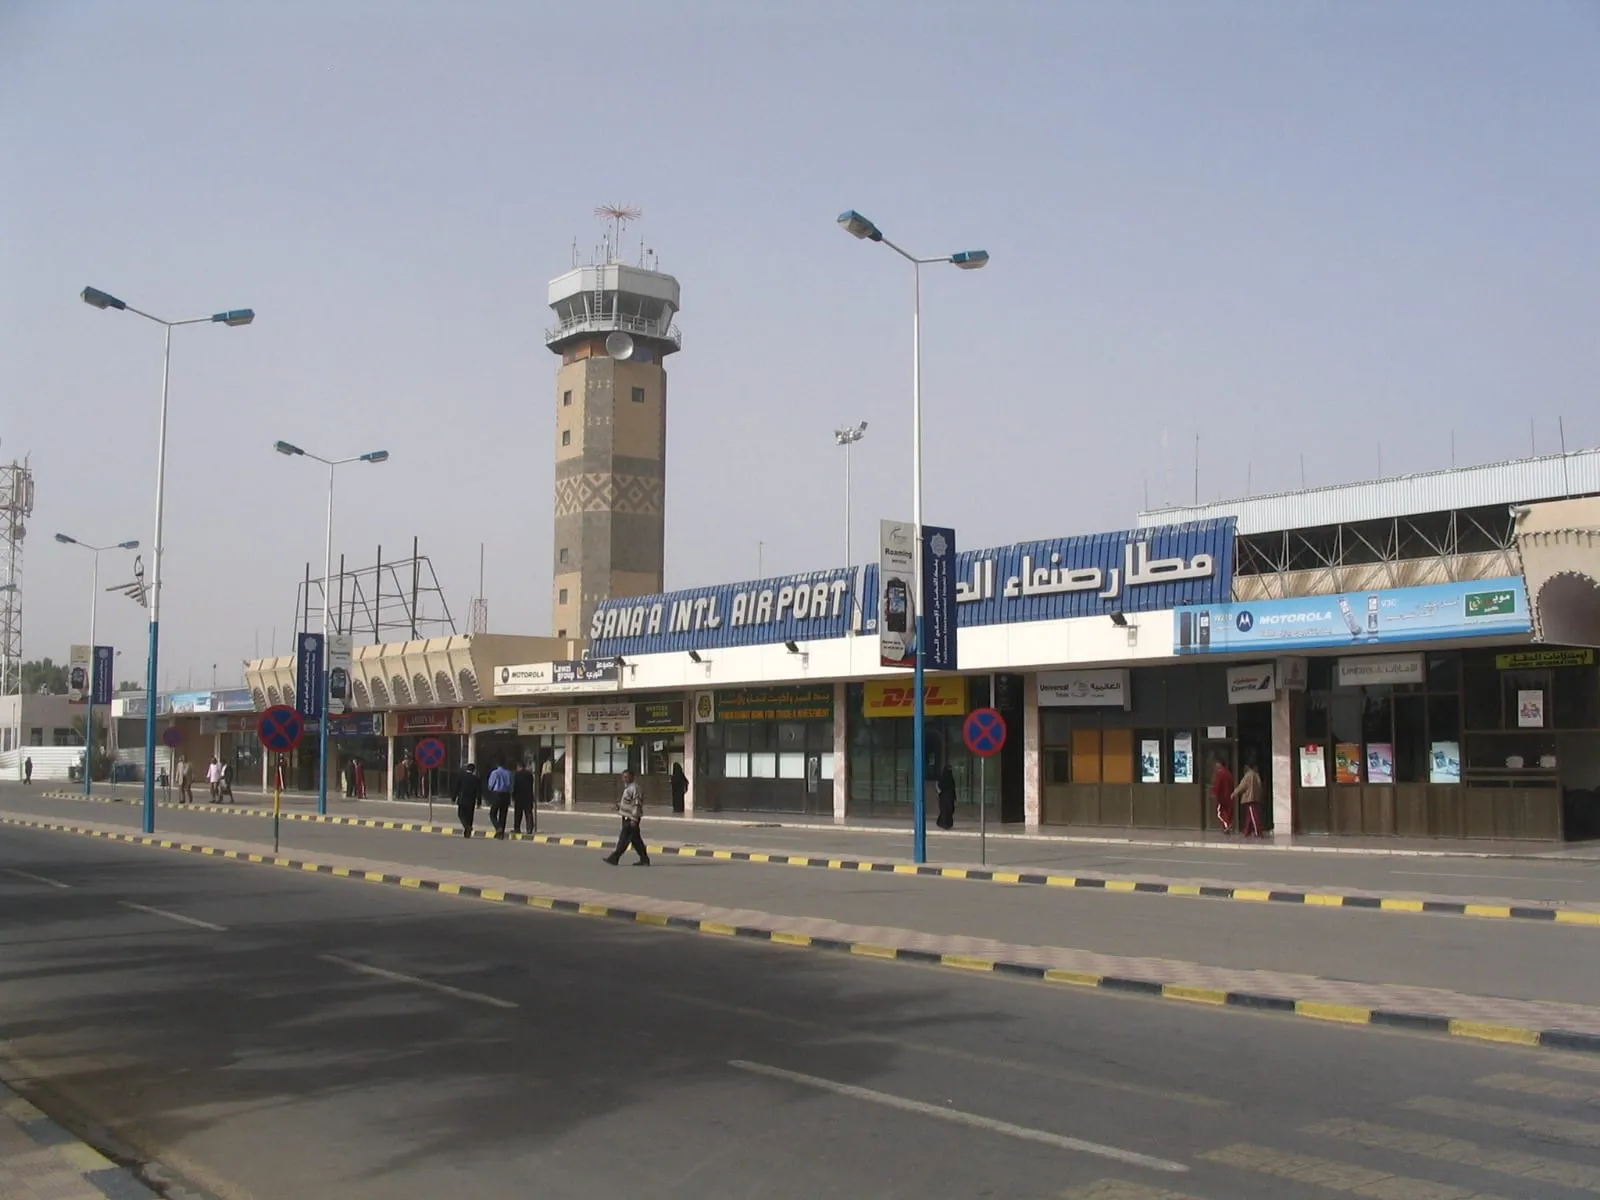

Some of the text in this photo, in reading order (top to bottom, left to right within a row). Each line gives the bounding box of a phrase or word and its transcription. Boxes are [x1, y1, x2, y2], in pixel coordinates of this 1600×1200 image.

[885, 548, 912, 559] Roaming
[1003, 553, 1102, 597] صنعاء
[1100, 541, 1213, 598] مطار
[590, 602, 662, 640] SANA'A
[730, 580, 846, 627] AIRPORT
[1259, 611, 1332, 625] MOTOROLA
[511, 671, 544, 679] MOTOROLA
[882, 687, 941, 707] DHL
